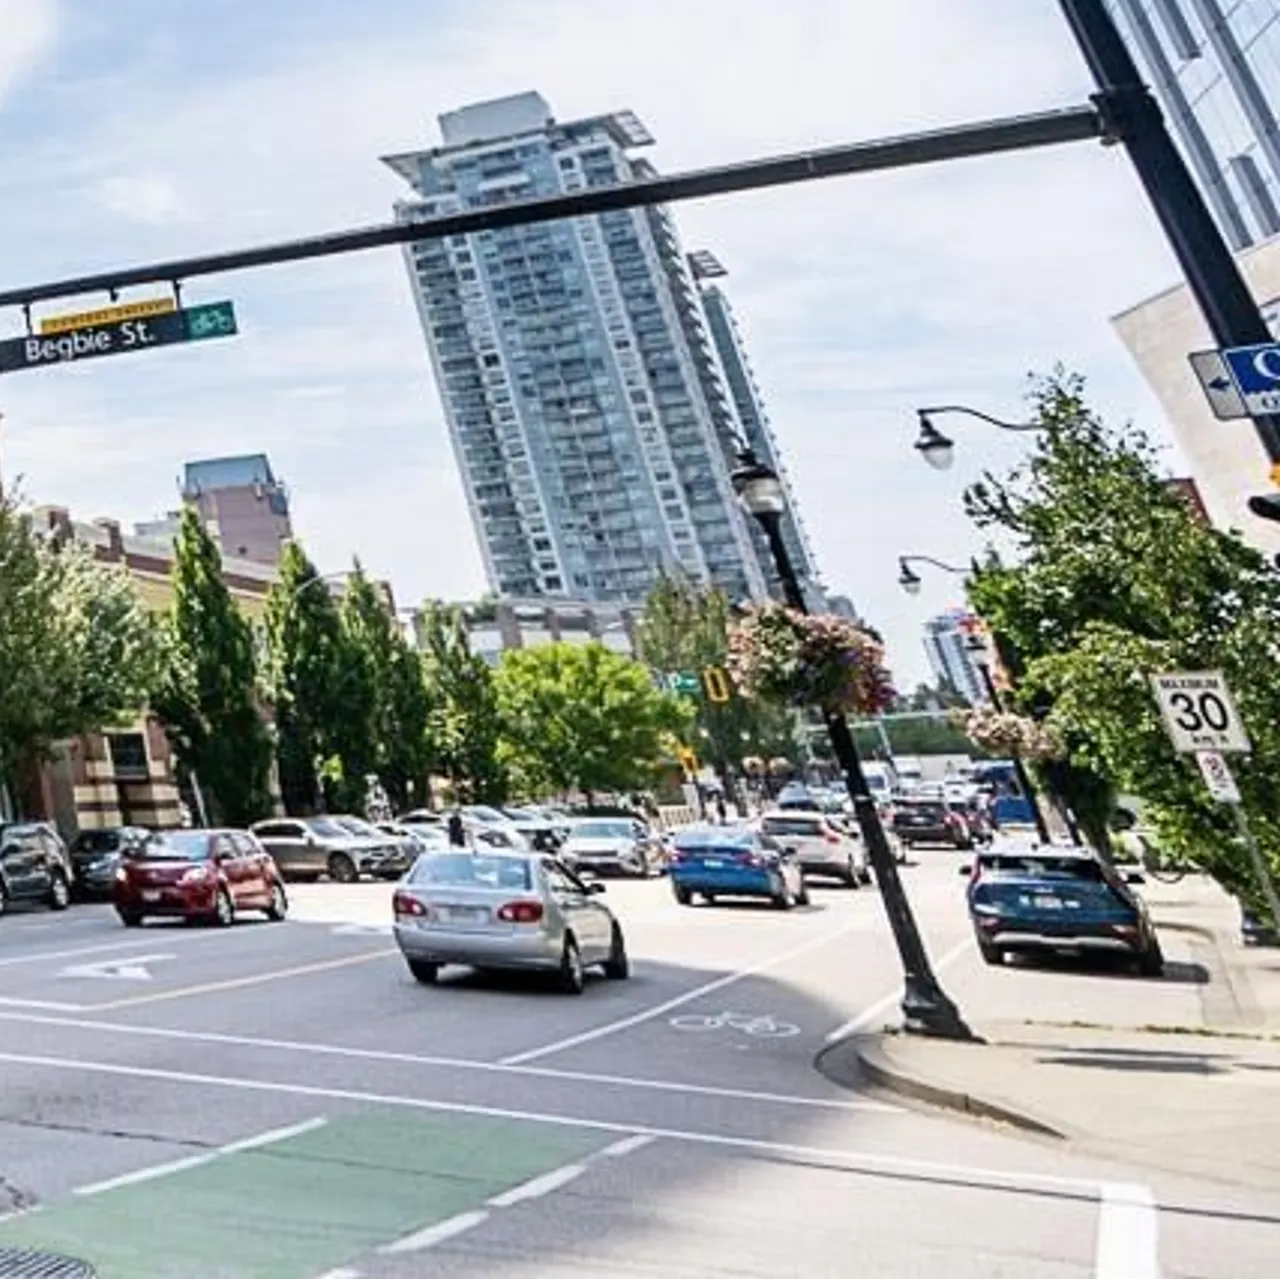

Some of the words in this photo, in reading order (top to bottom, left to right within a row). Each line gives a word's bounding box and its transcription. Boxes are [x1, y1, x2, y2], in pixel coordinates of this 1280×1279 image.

[25, 328, 111, 361] Begbie
[121, 321, 155, 345] St.
[1170, 691, 1228, 731] 30
